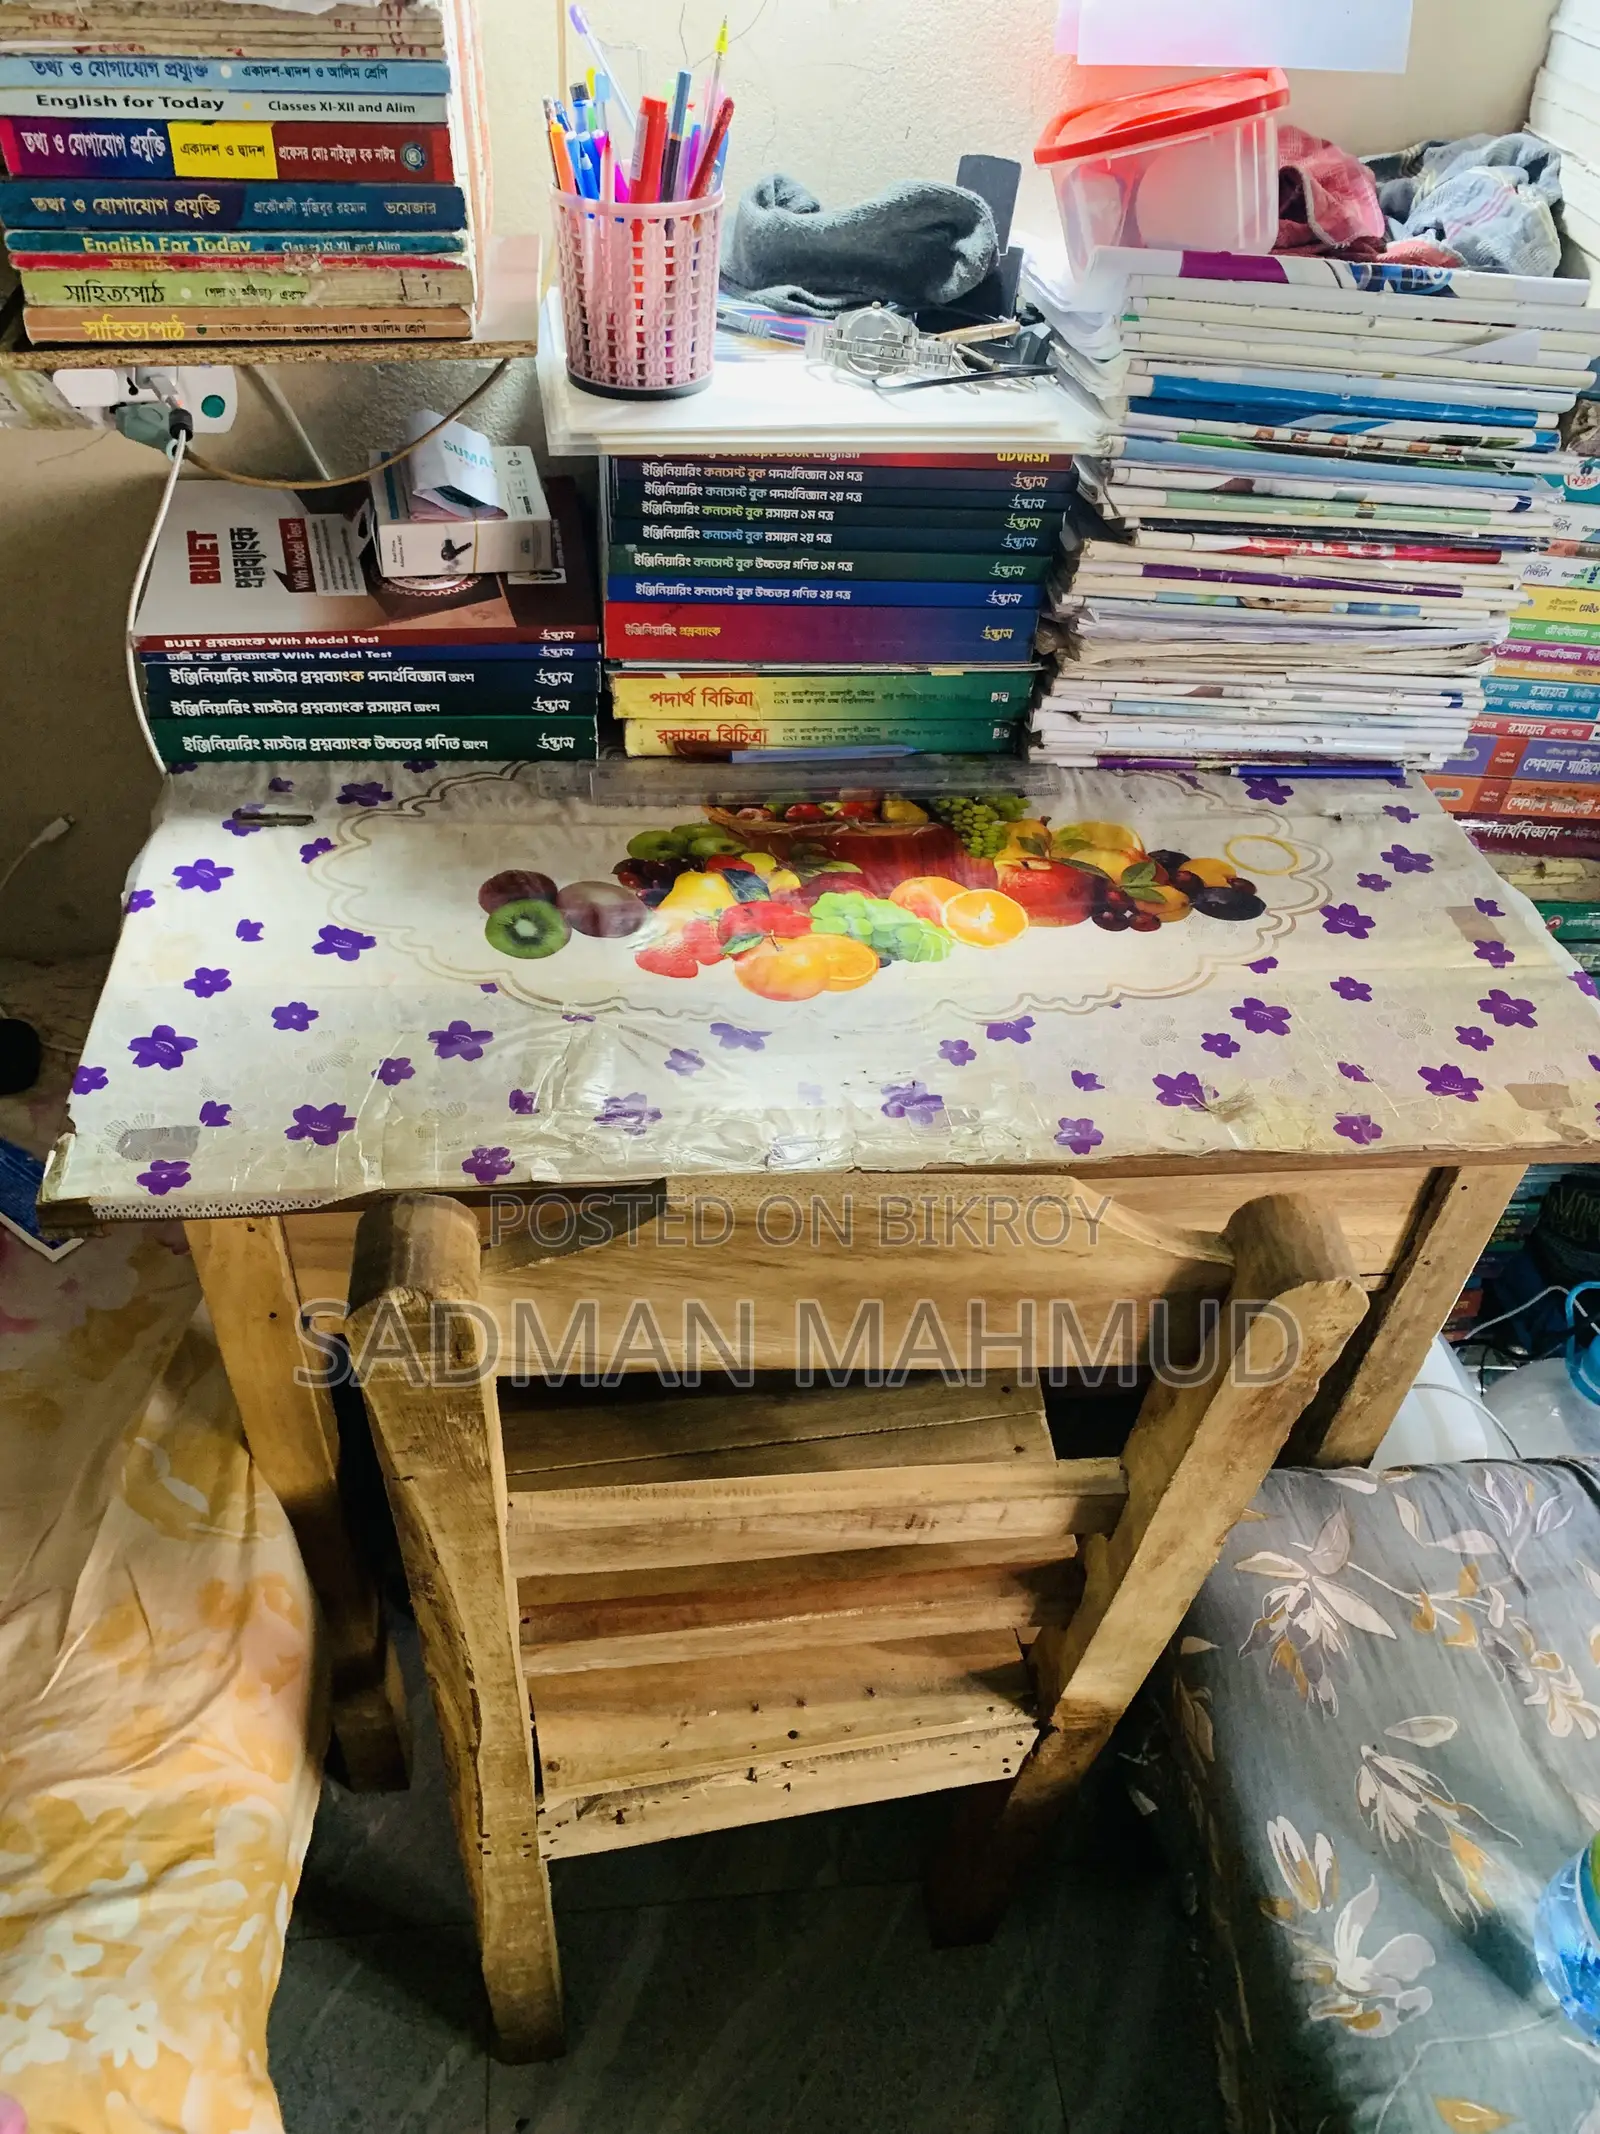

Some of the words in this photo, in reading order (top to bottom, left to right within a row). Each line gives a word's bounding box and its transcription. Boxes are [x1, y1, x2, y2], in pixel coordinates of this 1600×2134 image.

[71, 62, 83, 76] ও
[88, 60, 160, 78] যোগাযোগ
[315, 67, 324, 79] ও
[328, 63, 359, 79] আলিম
[36, 94, 117, 109] English
[125, 95, 154, 108] for
[158, 96, 224, 112] Today
[268, 100, 316, 112] Classes
[319, 101, 354, 113] XI-XII
[358, 102, 383, 113] and
[386, 102, 416, 114] Alim
[20, 130, 49, 157] তথ্য
[53, 134, 65, 155] ও
[68, 131, 127, 158] যোগাযোগ
[130, 128, 166, 164] প্রযুক্তি
[180, 143, 220, 157] একাদশ
[225, 144, 234, 156] ও
[359, 148, 373, 163] হক
[31, 197, 66, 212] তথ্য
[73, 199, 86, 213] ও
[93, 197, 168, 216] যোগাযোগ
[174, 193, 220, 220] প্রযুক্তি
[337, 202, 367, 214] রহমান
[82, 237, 155, 253] English
[158, 238, 189, 253] For
[193, 236, 251, 253] Today
[355, 241, 374, 252] and
[377, 241, 401, 251] Alim
[63, 278, 166, 304] সাহিত্যপাঠ
[82, 313, 186, 340] সাহিত্যপাঠ
[704, 466, 745, 478] কনসেপ্ট
[748, 469, 766, 481] বুক
[768, 466, 826, 481] পদার্থবিজ্ঞান
[829, 471, 844, 481] ১ম
[847, 471, 863, 482] পত্র
[706, 485, 746, 498] কনসেপ্ট
[749, 488, 767, 501] বুক
[769, 487, 827, 501] পদার্থবিজ্ঞান
[829, 491, 844, 503] ২য়
[846, 491, 863, 503] পত্র
[702, 505, 743, 517] কনসেপ্ট
[746, 508, 763, 521] বুক
[765, 508, 798, 520] রসায়ন
[800, 510, 815, 520] ১ম
[818, 510, 834, 521] পত্র
[286, 522, 303, 539] Test
[702, 528, 743, 541] কনসেপ্ট
[745, 532, 763, 545] বুক
[765, 532, 798, 543] রসায়ন
[800, 533, 814, 543] ২য়
[816, 533, 832, 544] পত্র
[187, 530, 221, 584] BUET
[289, 541, 307, 569] Model
[693, 555, 734, 568] কনসেপ্ট
[736, 559, 753, 572] বুক
[755, 557, 791, 570] উচ্চতর
[793, 557, 819, 571] গণিত
[820, 561, 835, 571] ১ম
[837, 561, 853, 572] পত্র
[293, 570, 310, 590] With
[694, 585, 734, 597] কনসেপ্ট
[736, 588, 753, 600] বুক
[755, 586, 790, 598] উচ্চতর
[792, 587, 818, 599] গণিত
[820, 590, 833, 600] ২য়
[836, 590, 851, 600] পত্র
[164, 639, 201, 648] BUET
[268, 637, 301, 646] With
[305, 636, 349, 645] Model
[352, 635, 379, 645] Test
[282, 651, 314, 660] With
[319, 651, 362, 660] Model
[366, 651, 392, 659] Test
[253, 668, 297, 684] মাস্টার
[368, 667, 446, 684] পদার্থবিজ্ঞান
[449, 673, 475, 683] অংশ
[649, 687, 697, 708] পদার্থ
[701, 687, 754, 707] বিচিত্রা
[1529, 685, 1569, 699] রসায়ন
[253, 700, 298, 715] মাস্টার
[367, 701, 411, 714] রসায়ন
[414, 703, 440, 713] অংশ
[656, 727, 711, 744] রসায়ন
[716, 724, 770, 745] বিচিত্রা
[1507, 722, 1546, 736] রসায়ন
[263, 735, 306, 751] মাস্টার
[374, 735, 423, 751] উচ্চতর
[425, 734, 460, 750] গণিত
[463, 740, 488, 750] অংশ
